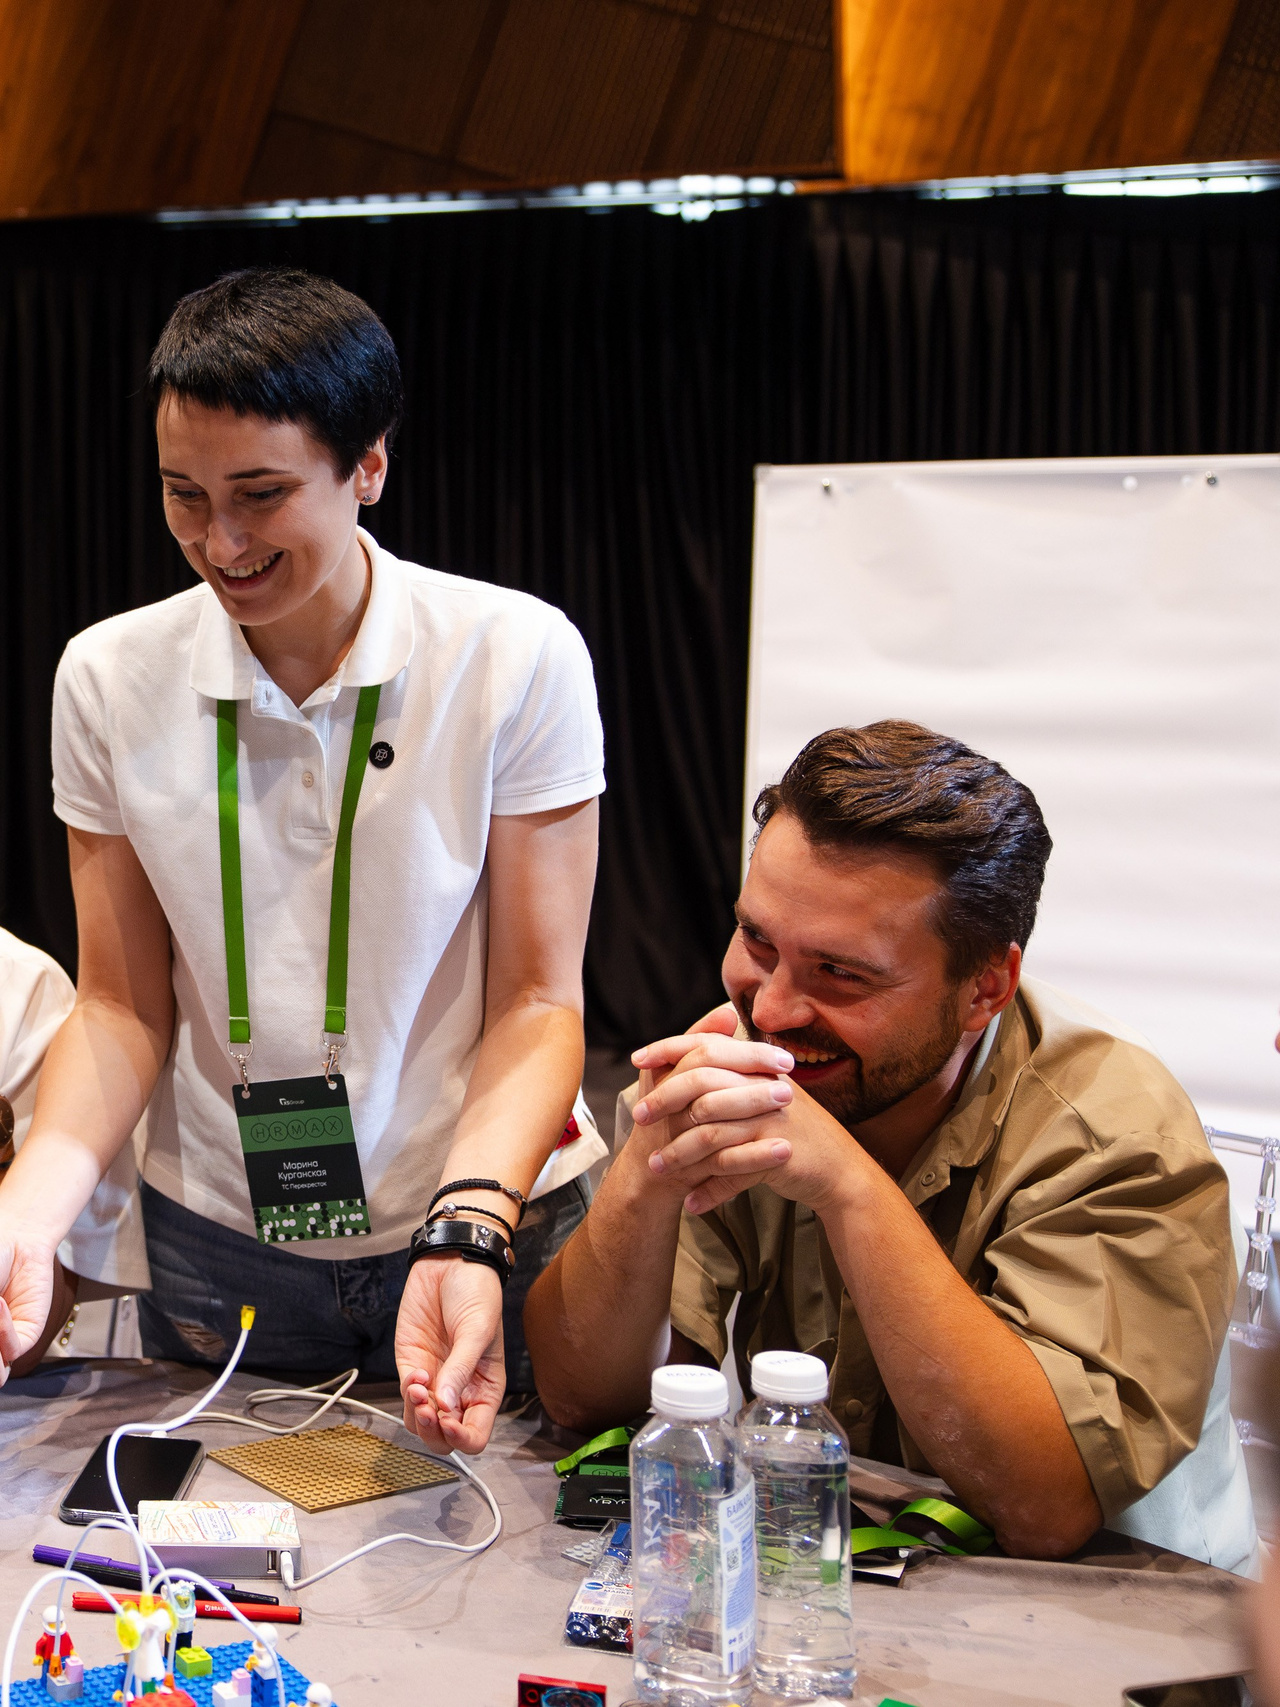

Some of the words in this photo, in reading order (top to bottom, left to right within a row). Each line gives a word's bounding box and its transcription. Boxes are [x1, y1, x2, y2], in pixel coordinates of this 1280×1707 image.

[254, 1118, 340, 1140] HRMAX
[282, 1160, 319, 1170] Марина
[277, 1169, 327, 1181] Курганская
